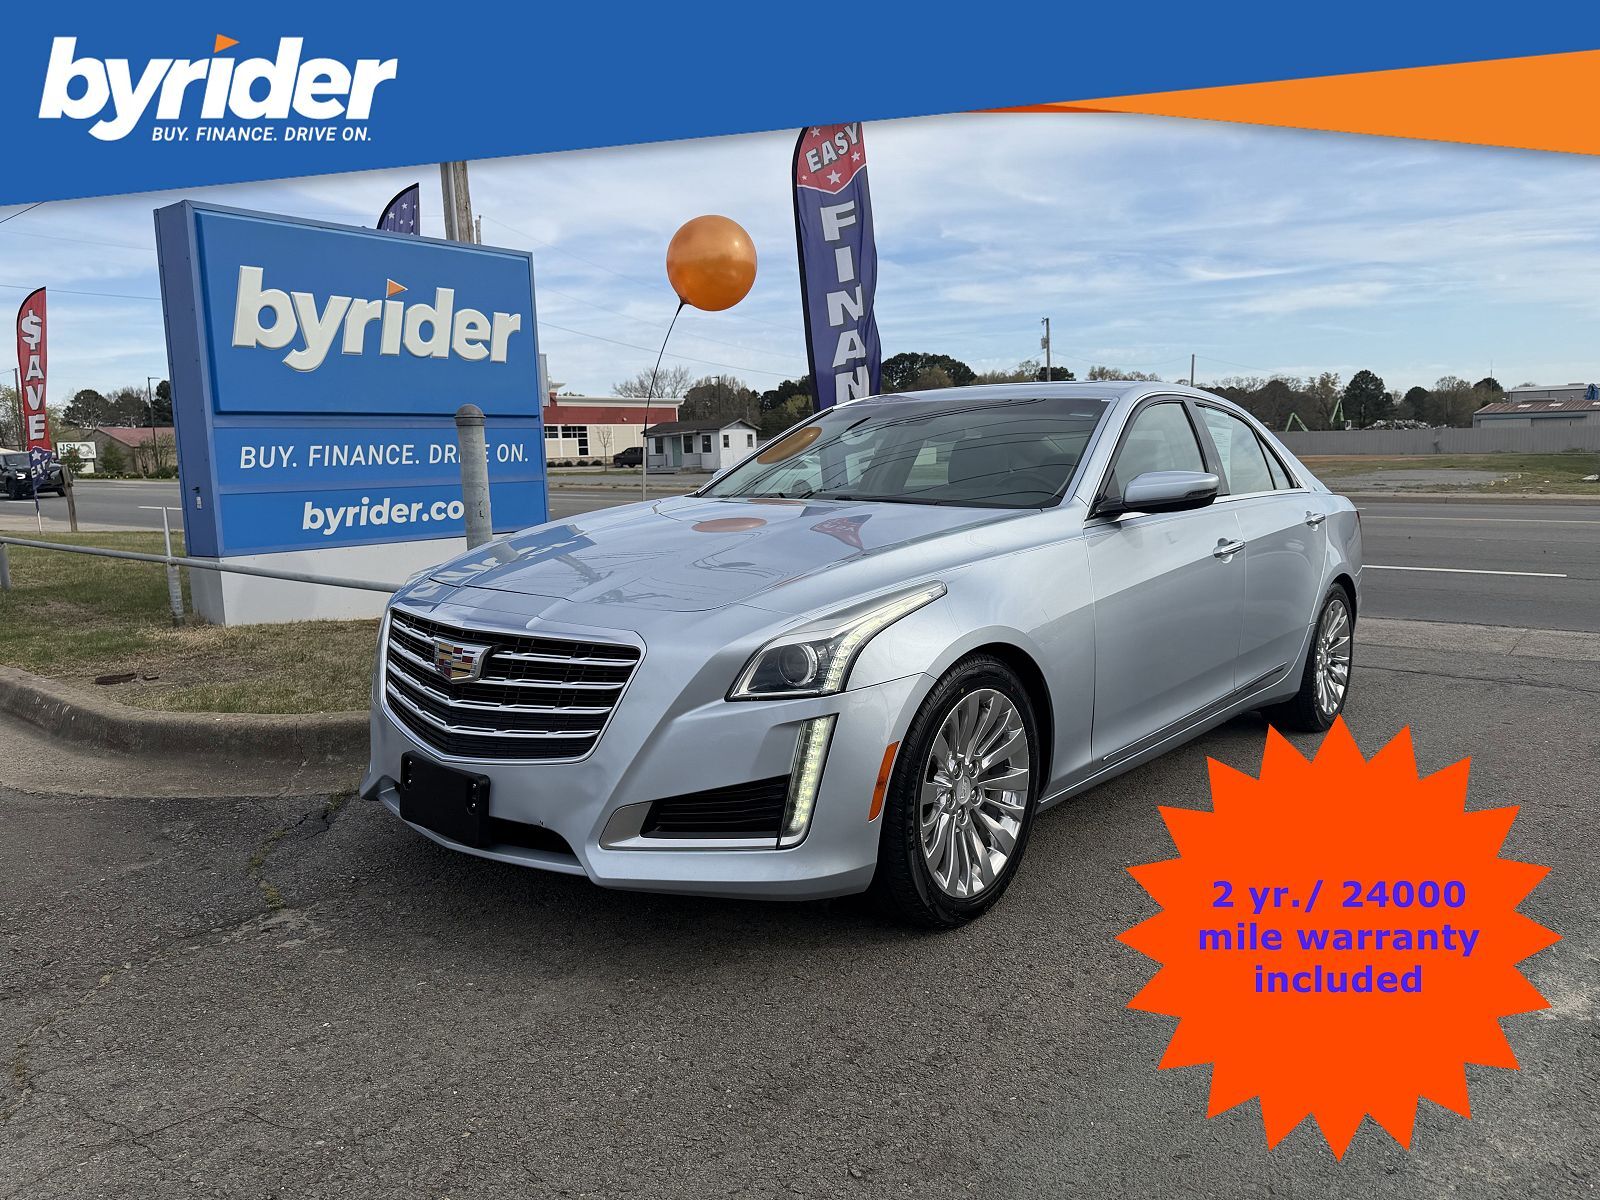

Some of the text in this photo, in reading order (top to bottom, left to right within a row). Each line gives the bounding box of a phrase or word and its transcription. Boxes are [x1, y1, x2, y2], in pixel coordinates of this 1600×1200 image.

[805, 122, 858, 173] EASY
[232, 266, 521, 373] byrider
[240, 443, 529, 469] BUY. FINANCE. DRE ON.
[302, 497, 465, 535] byrider.co
